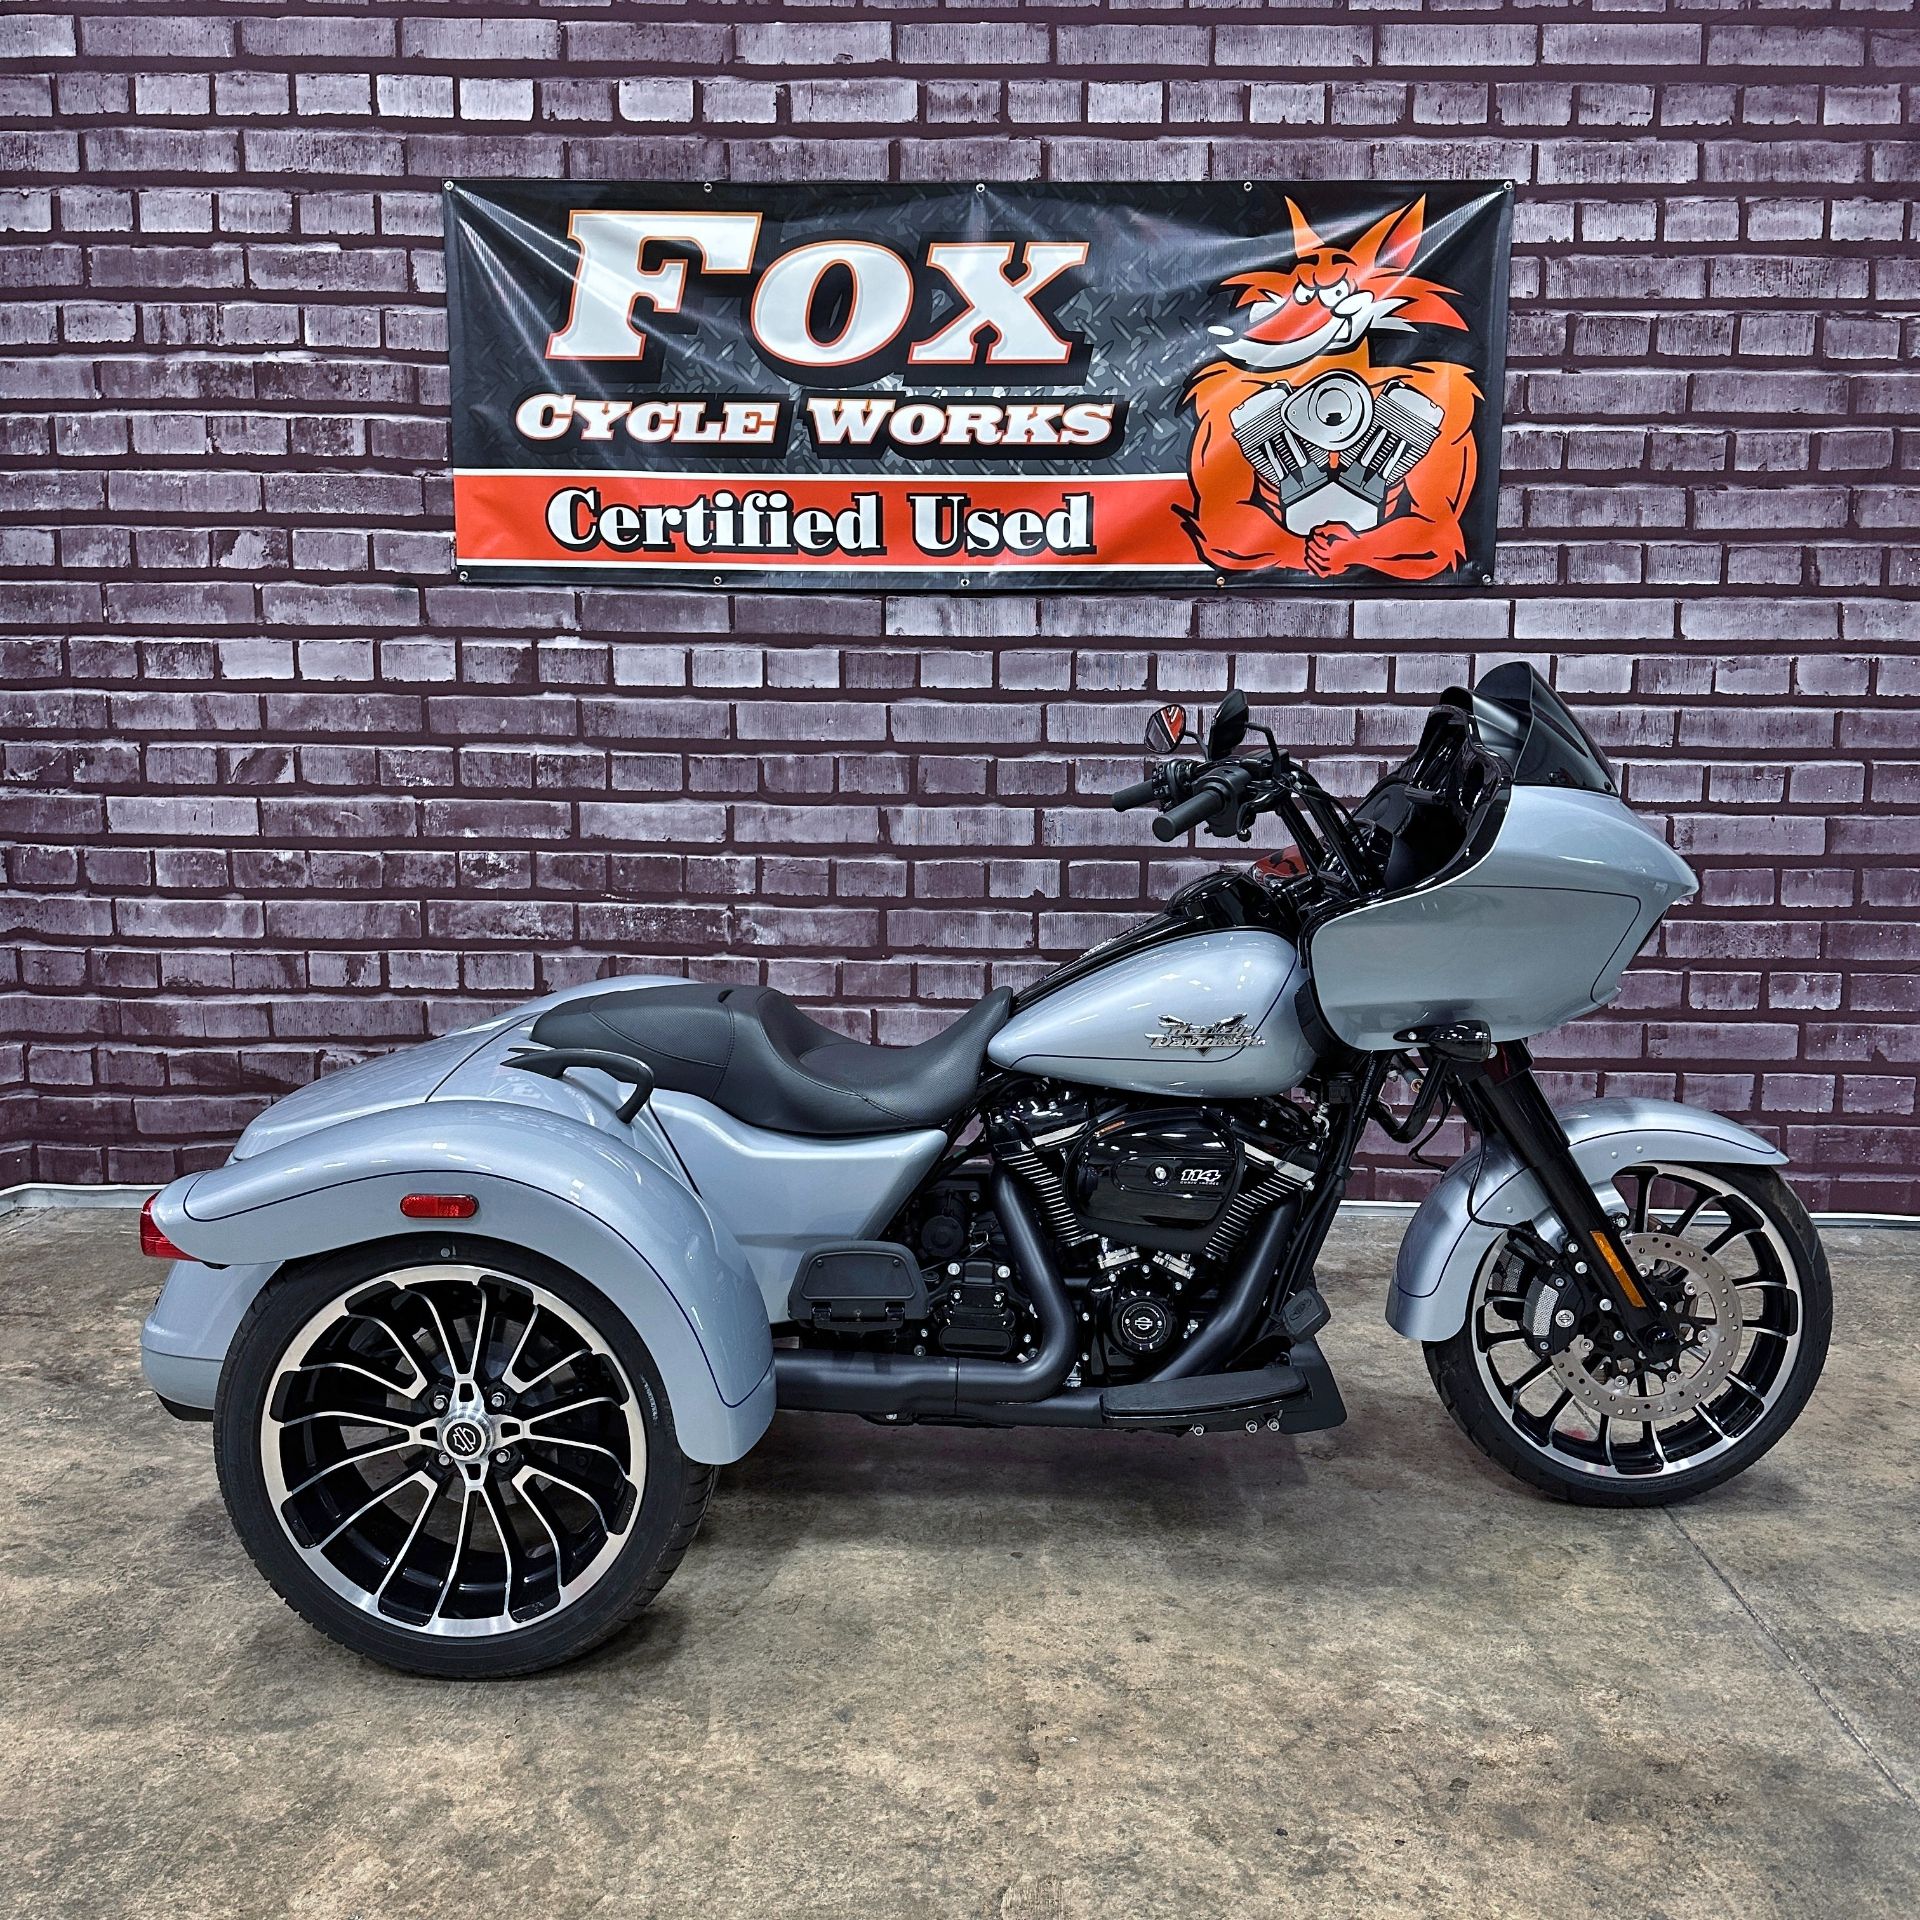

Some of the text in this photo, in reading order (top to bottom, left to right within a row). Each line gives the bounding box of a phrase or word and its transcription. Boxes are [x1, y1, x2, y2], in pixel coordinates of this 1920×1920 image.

[545, 210, 1090, 366] FOX
[515, 394, 1114, 446] CYCLE WORKS
[546, 489, 1092, 553] Certified Used
[1181, 1169, 1221, 1182] 114
